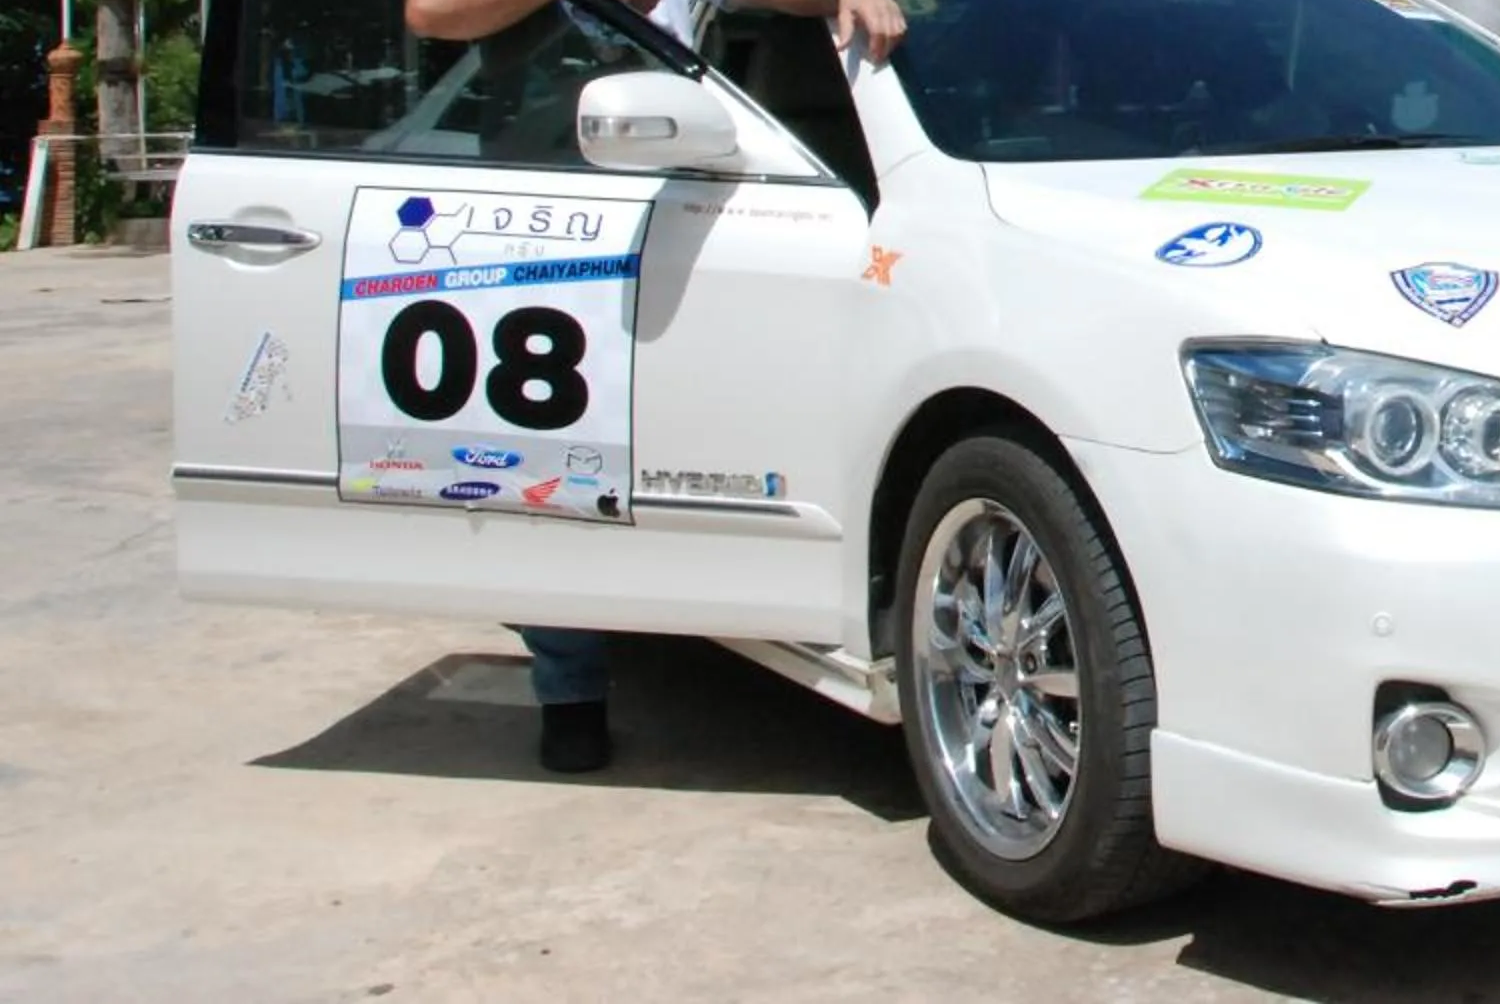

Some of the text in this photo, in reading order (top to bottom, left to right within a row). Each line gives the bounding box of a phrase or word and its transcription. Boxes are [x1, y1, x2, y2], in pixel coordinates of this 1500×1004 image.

[445, 267, 508, 289] GROUP
[513, 256, 633, 283] CHAIYAPHUM
[380, 298, 590, 431] 08
